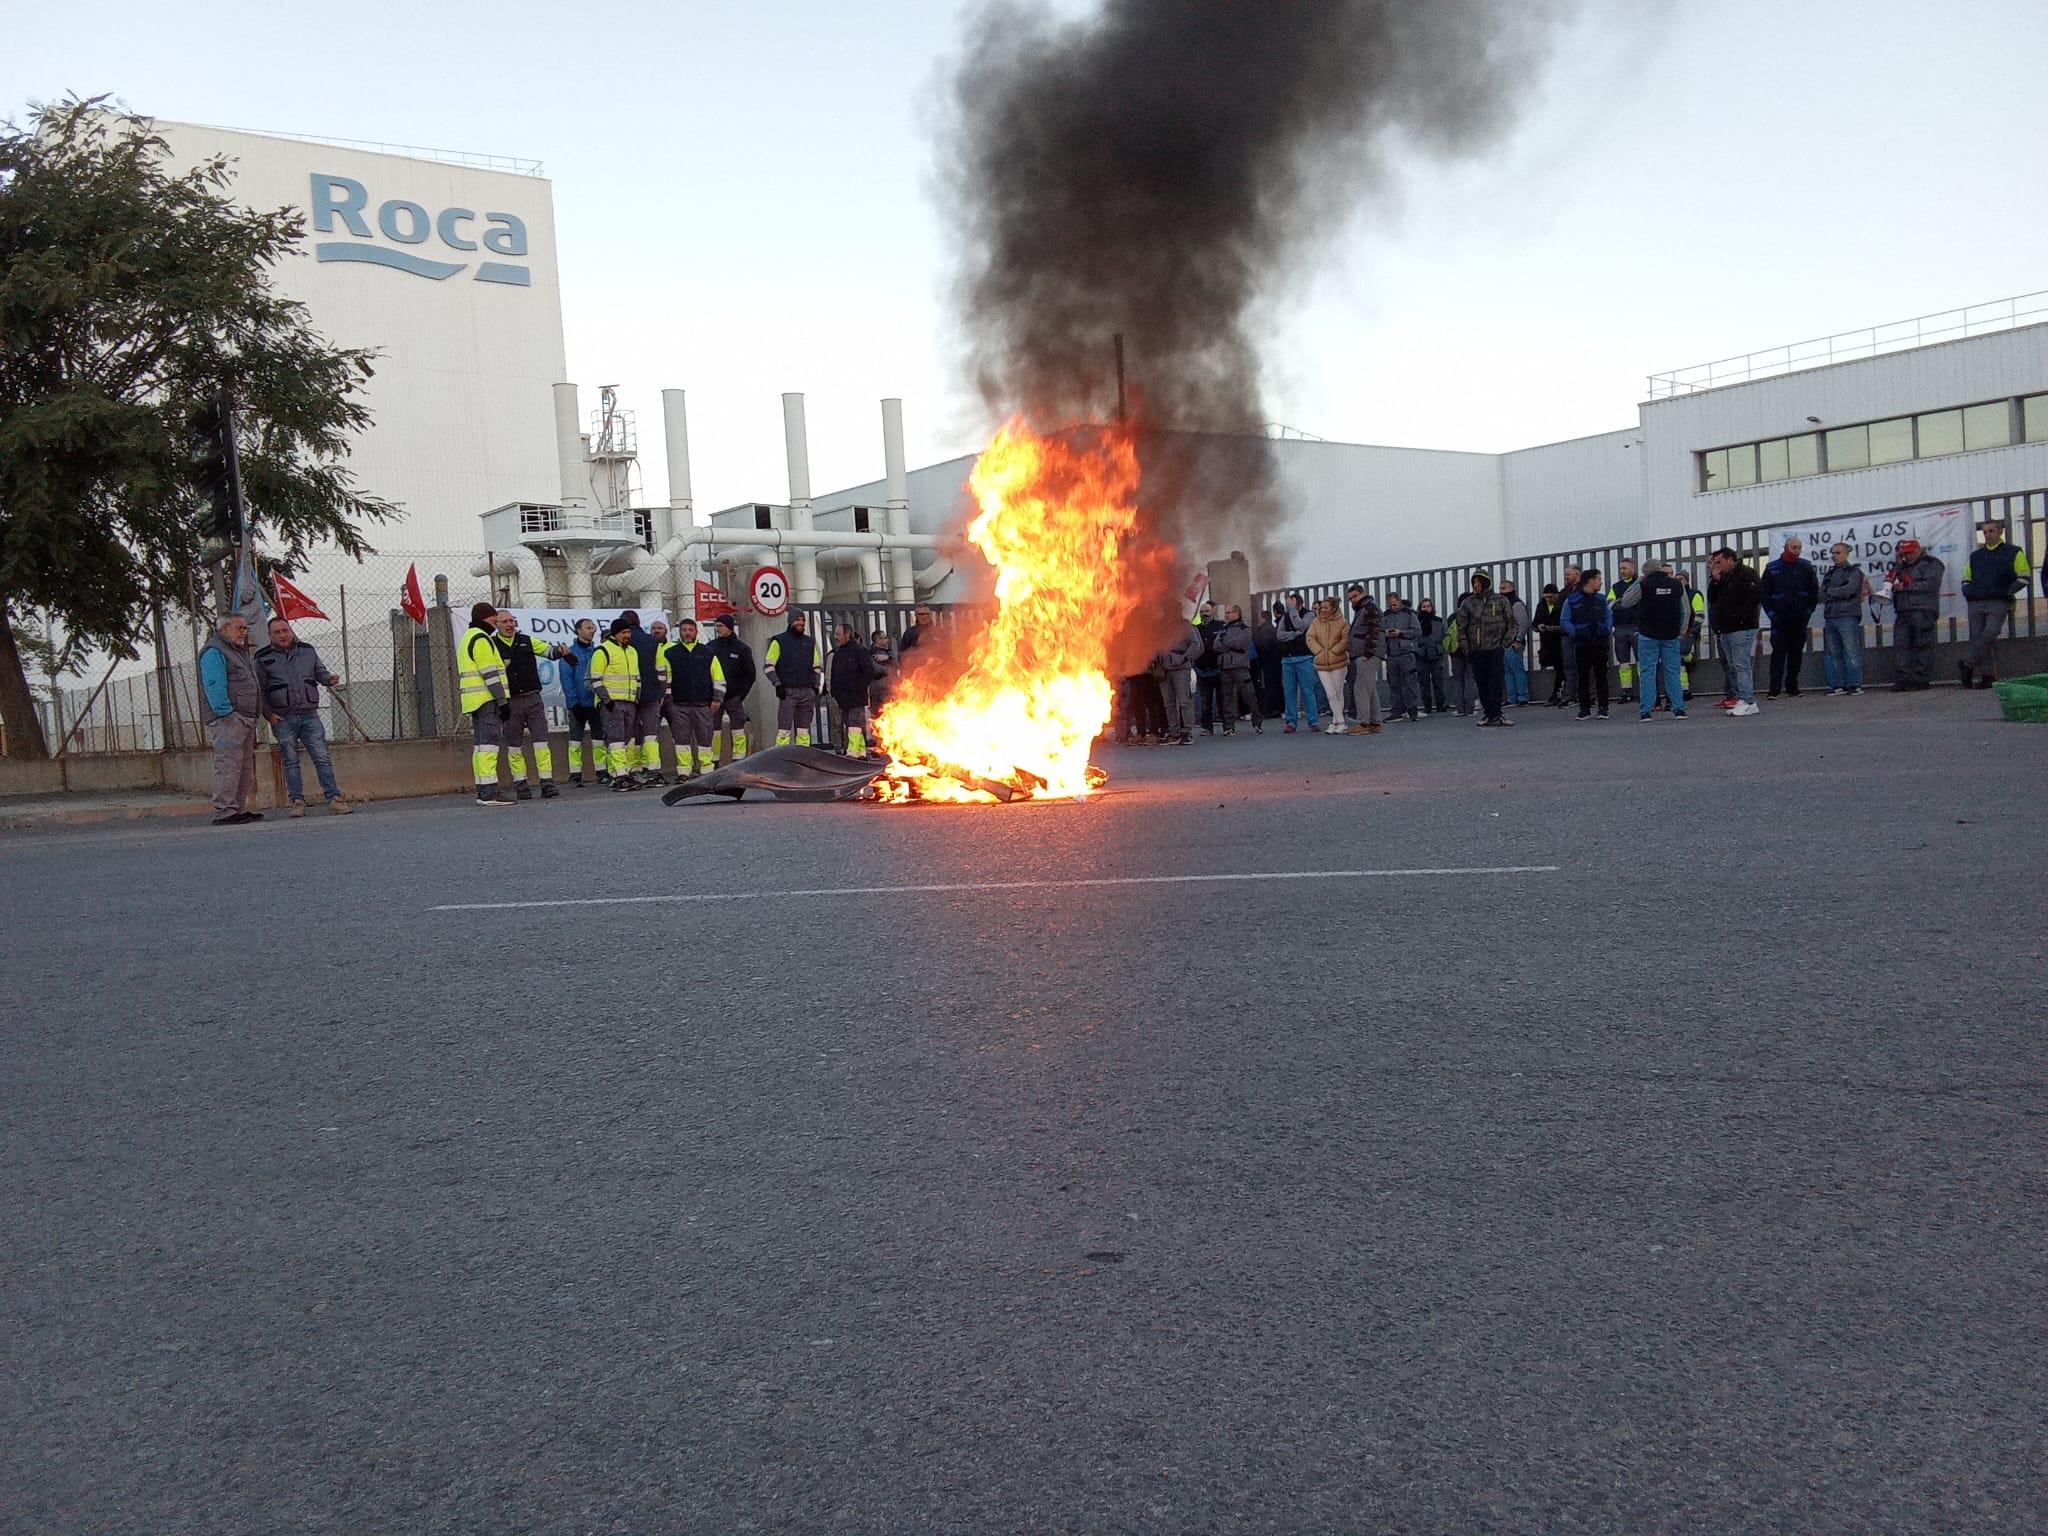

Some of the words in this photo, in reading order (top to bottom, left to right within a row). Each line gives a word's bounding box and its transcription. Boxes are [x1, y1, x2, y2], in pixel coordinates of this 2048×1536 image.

[310, 173, 528, 255] Roca
[1809, 531, 1831, 546] NO
[1873, 521, 1908, 538] LOS
[760, 582, 781, 598] 20
